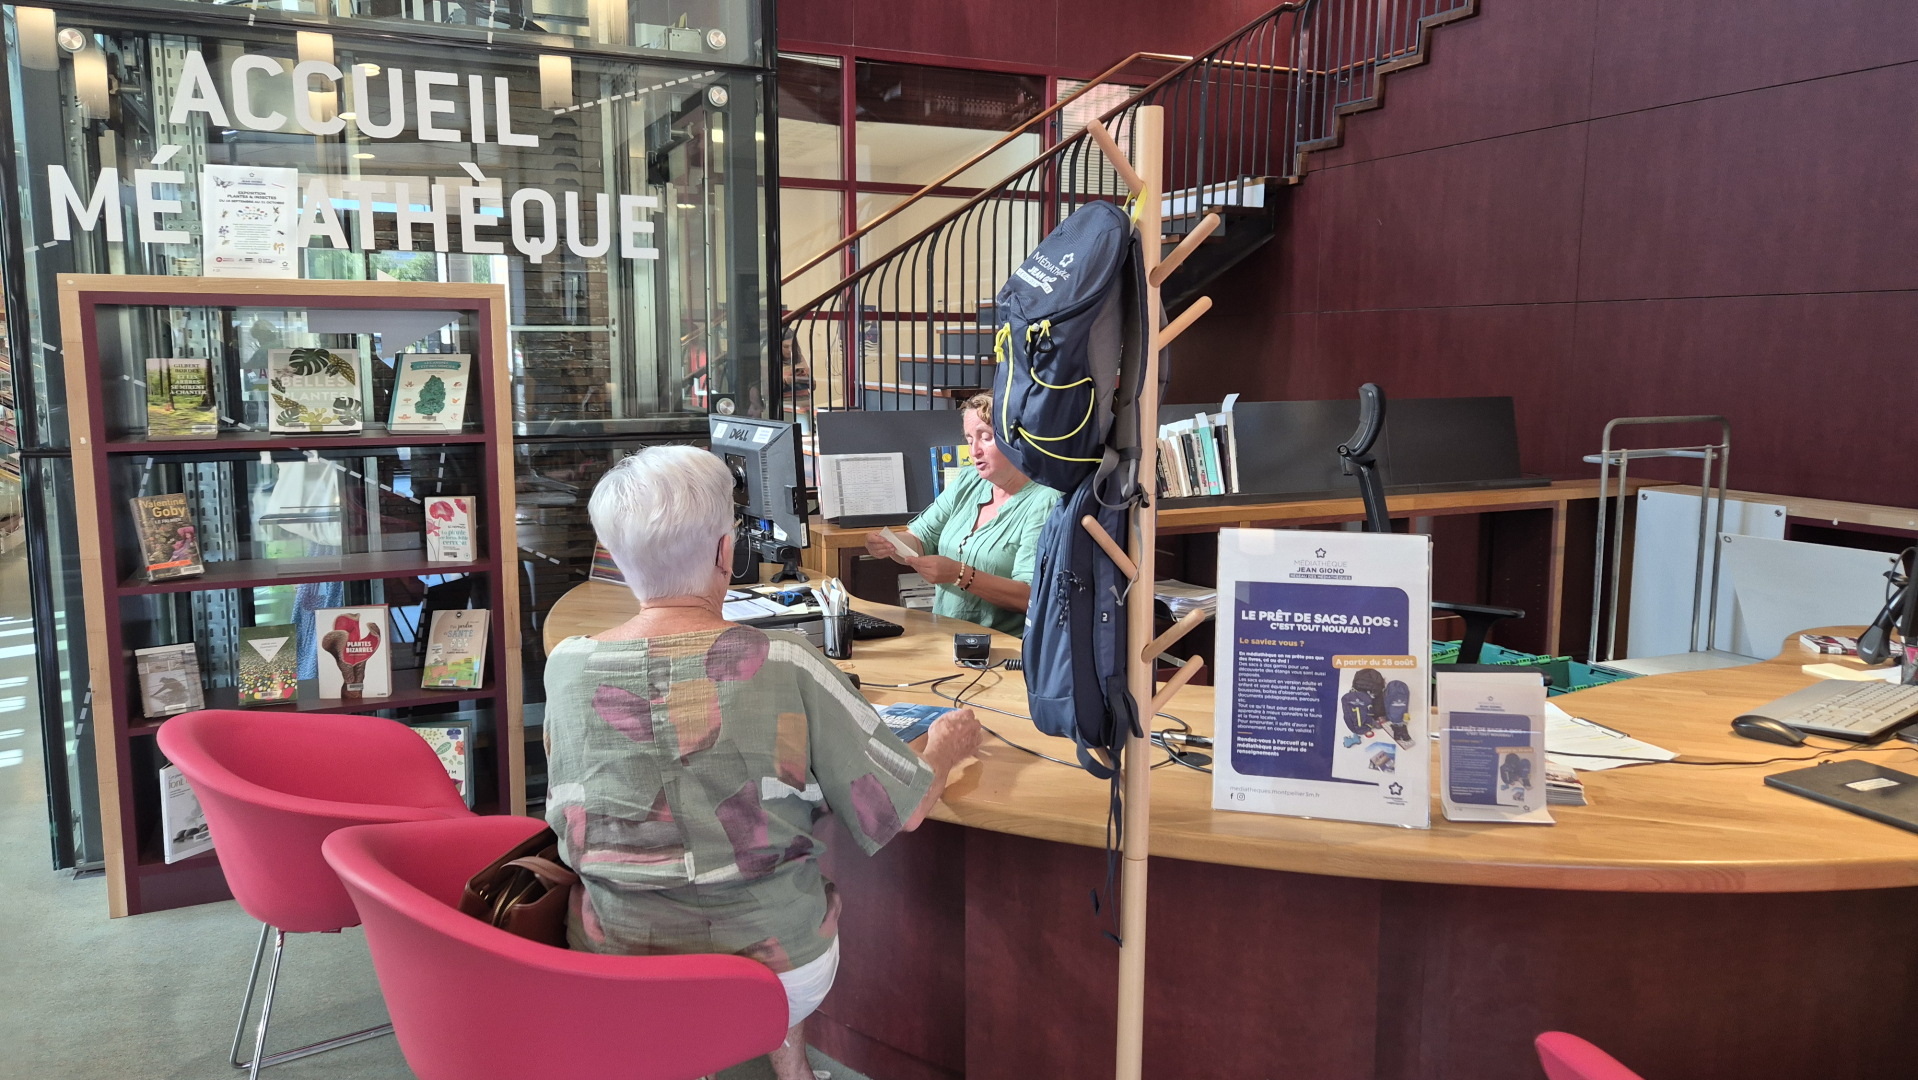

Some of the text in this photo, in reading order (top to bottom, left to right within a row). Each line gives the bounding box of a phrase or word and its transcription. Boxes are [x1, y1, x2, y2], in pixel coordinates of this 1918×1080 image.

[169, 50, 540, 148] ACCUEIL
[47, 144, 660, 264] MÉATHÈQUE
[282, 376, 347, 387] BELLES
[282, 391, 347, 401] PLANTES
[729, 428, 749, 441] DELL
[141, 499, 185, 508] Valentine
[152, 506, 185, 518] Goby
[1241, 610, 1256, 620] LE
[1259, 609, 1291, 623] PRÊT
[1294, 612, 1311, 623] DE
[1314, 614, 1347, 625] SACS
[1350, 615, 1360, 625] A
[1363, 616, 1391, 627] DOS
[1322, 625, 1365, 634] NOUVEAU
[1346, 658, 1367, 668] partir
[1394, 658, 1414, 666] août
